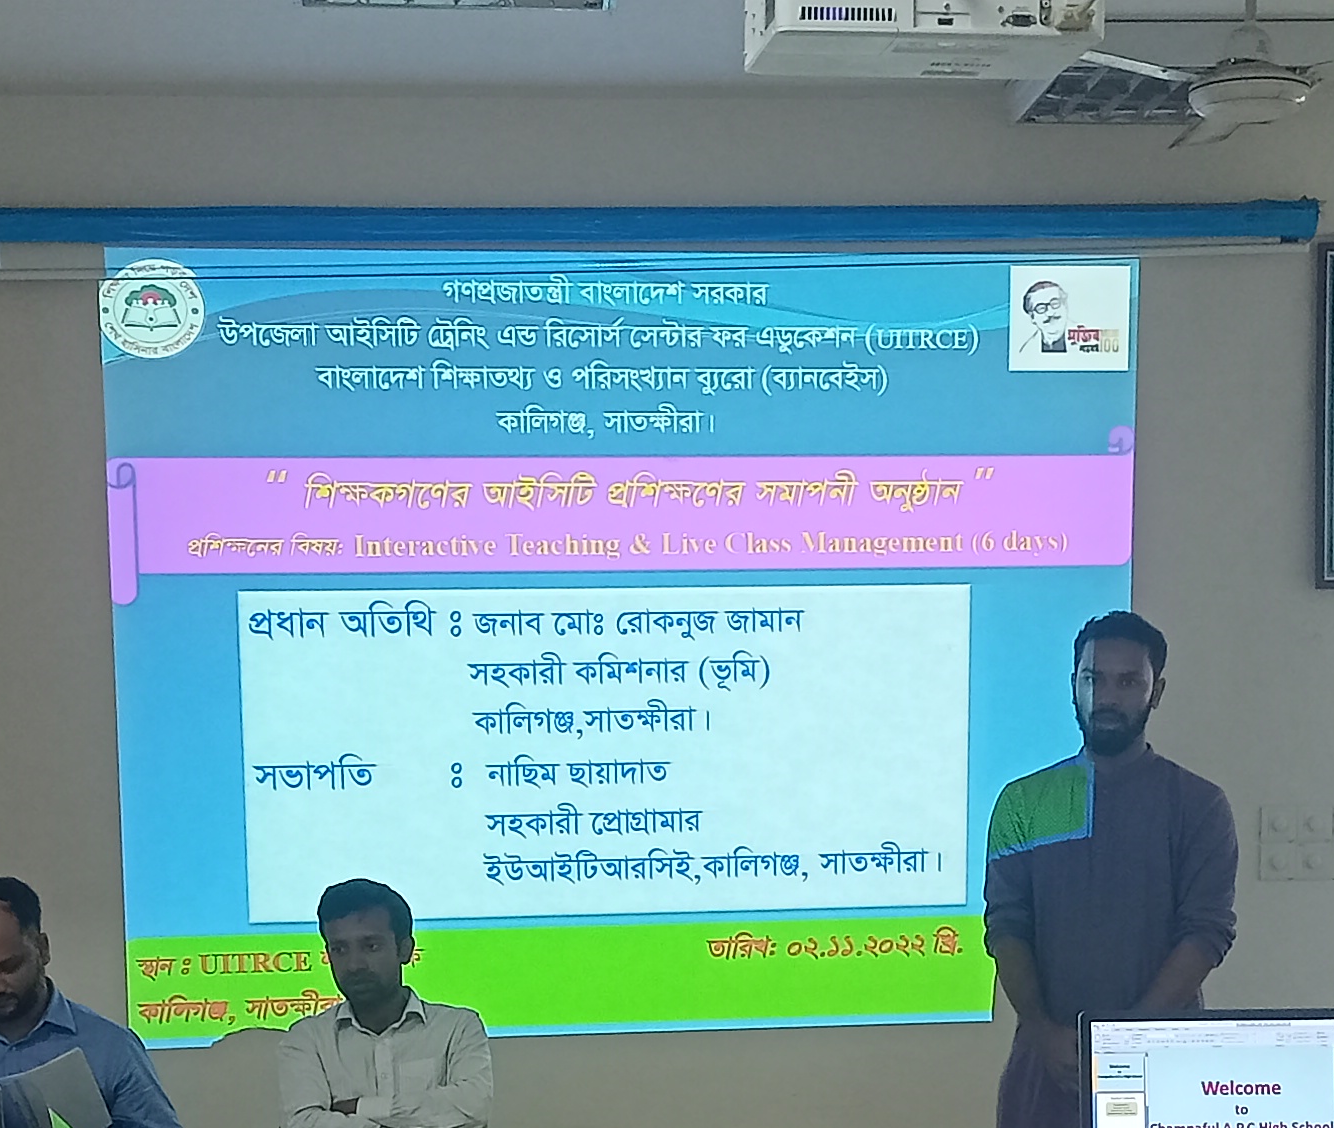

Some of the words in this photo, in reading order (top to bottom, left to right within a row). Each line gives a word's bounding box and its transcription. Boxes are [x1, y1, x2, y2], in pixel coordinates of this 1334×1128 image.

[443, 272, 571, 306] গণপ্রজাতন্ত্রী
[580, 279, 683, 306] বাংলাদেশ
[692, 282, 769, 307] সরকার
[219, 317, 318, 348] উপজেলা
[325, 317, 420, 348] আইসিটি
[428, 317, 487, 348] ট্রেনিং
[497, 326, 537, 347] এন্ড
[543, 317, 623, 348] রিসোর্স
[629, 324, 704, 350] সেন্টার
[711, 327, 749, 347] ফর
[757, 327, 857, 356] এডুকেশন
[865, 327, 980, 356] (UITRCE)
[317, 366, 425, 392] বাংলাদেশ
[432, 359, 534, 392] শিক্ষাতথ্য
[543, 369, 563, 390] ও
[571, 360, 689, 392] পরিসংখ্যান
[696, 366, 756, 398] ব্যুরো
[761, 360, 889, 398] (ব্যানবেইস)
[496, 404, 596, 440] কালিগঞ্জ,
[303, 471, 473, 510] শিক্ষকগণের
[483, 472, 597, 509] আইসিটি
[607, 470, 746, 509] প্রশিক্ষণের
[755, 467, 859, 507] সমাপনী
[869, 468, 964, 513] অনুষ্ঠান
[354, 534, 496, 558] Interactive
[506, 532, 621, 561] Teaching
[629, 534, 651, 556] &
[660, 532, 718, 556] Live
[724, 531, 792, 556] Class
[800, 531, 964, 560] Management
[971, 529, 997, 556] (6
[1002, 529, 1069, 557] days)
[247, 607, 328, 640] প্রধান
[338, 599, 434, 639] অতিথি
[472, 609, 543, 636] জনাব
[553, 609, 605, 636] মোঃ
[615, 609, 719, 640] রোকনুজ
[726, 607, 804, 635] জামান
[468, 651, 567, 685] সহকারী
[574, 650, 687, 684] কমিশনার
[699, 654, 770, 692] (ভূমি)
[253, 753, 373, 792] সভাপতি
[485, 755, 561, 787] নাছিম
[567, 758, 670, 787] ছায়াদাত
[486, 801, 583, 838] সহকারী
[591, 806, 704, 836] প্রোগ্রামার
[135, 956, 178, 982] স্থান
[198, 950, 314, 976] UITRCE
[1200, 1079, 1282, 1096] Welcome
[1234, 1104, 1249, 1116] to
